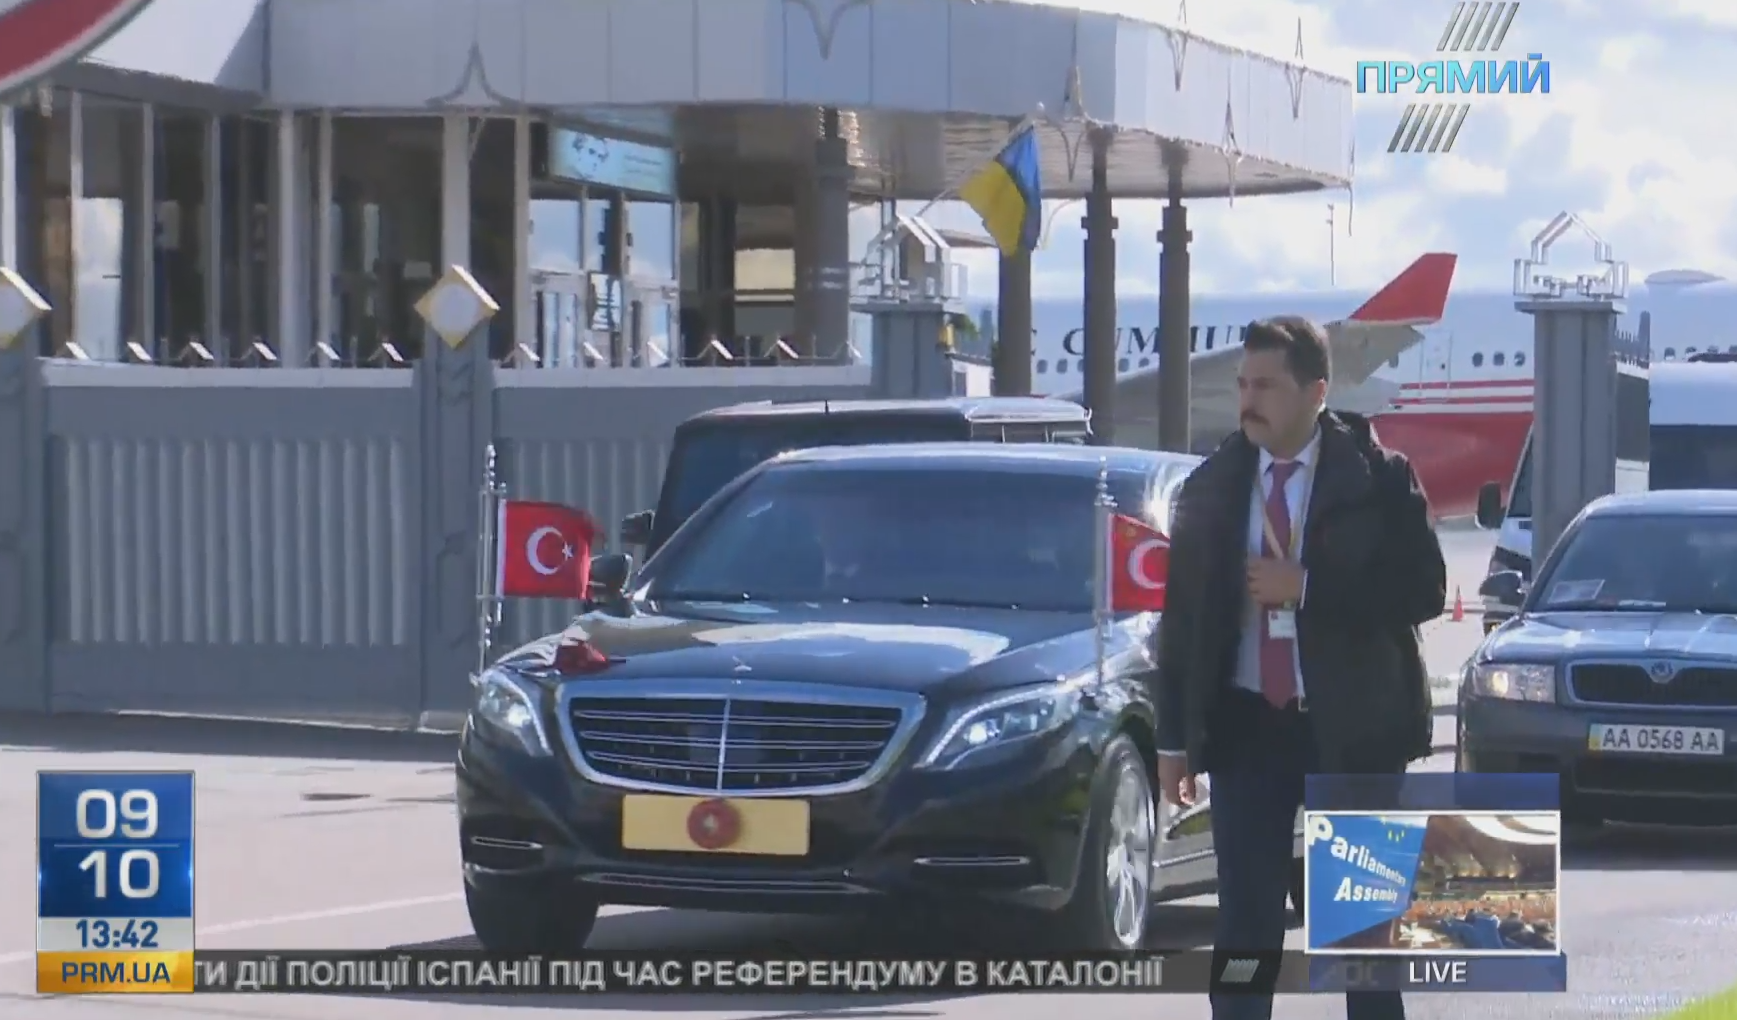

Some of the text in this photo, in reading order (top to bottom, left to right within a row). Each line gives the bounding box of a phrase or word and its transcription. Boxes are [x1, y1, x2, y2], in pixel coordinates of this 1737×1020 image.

[1602, 728, 1719, 751] AA 0568 AA
